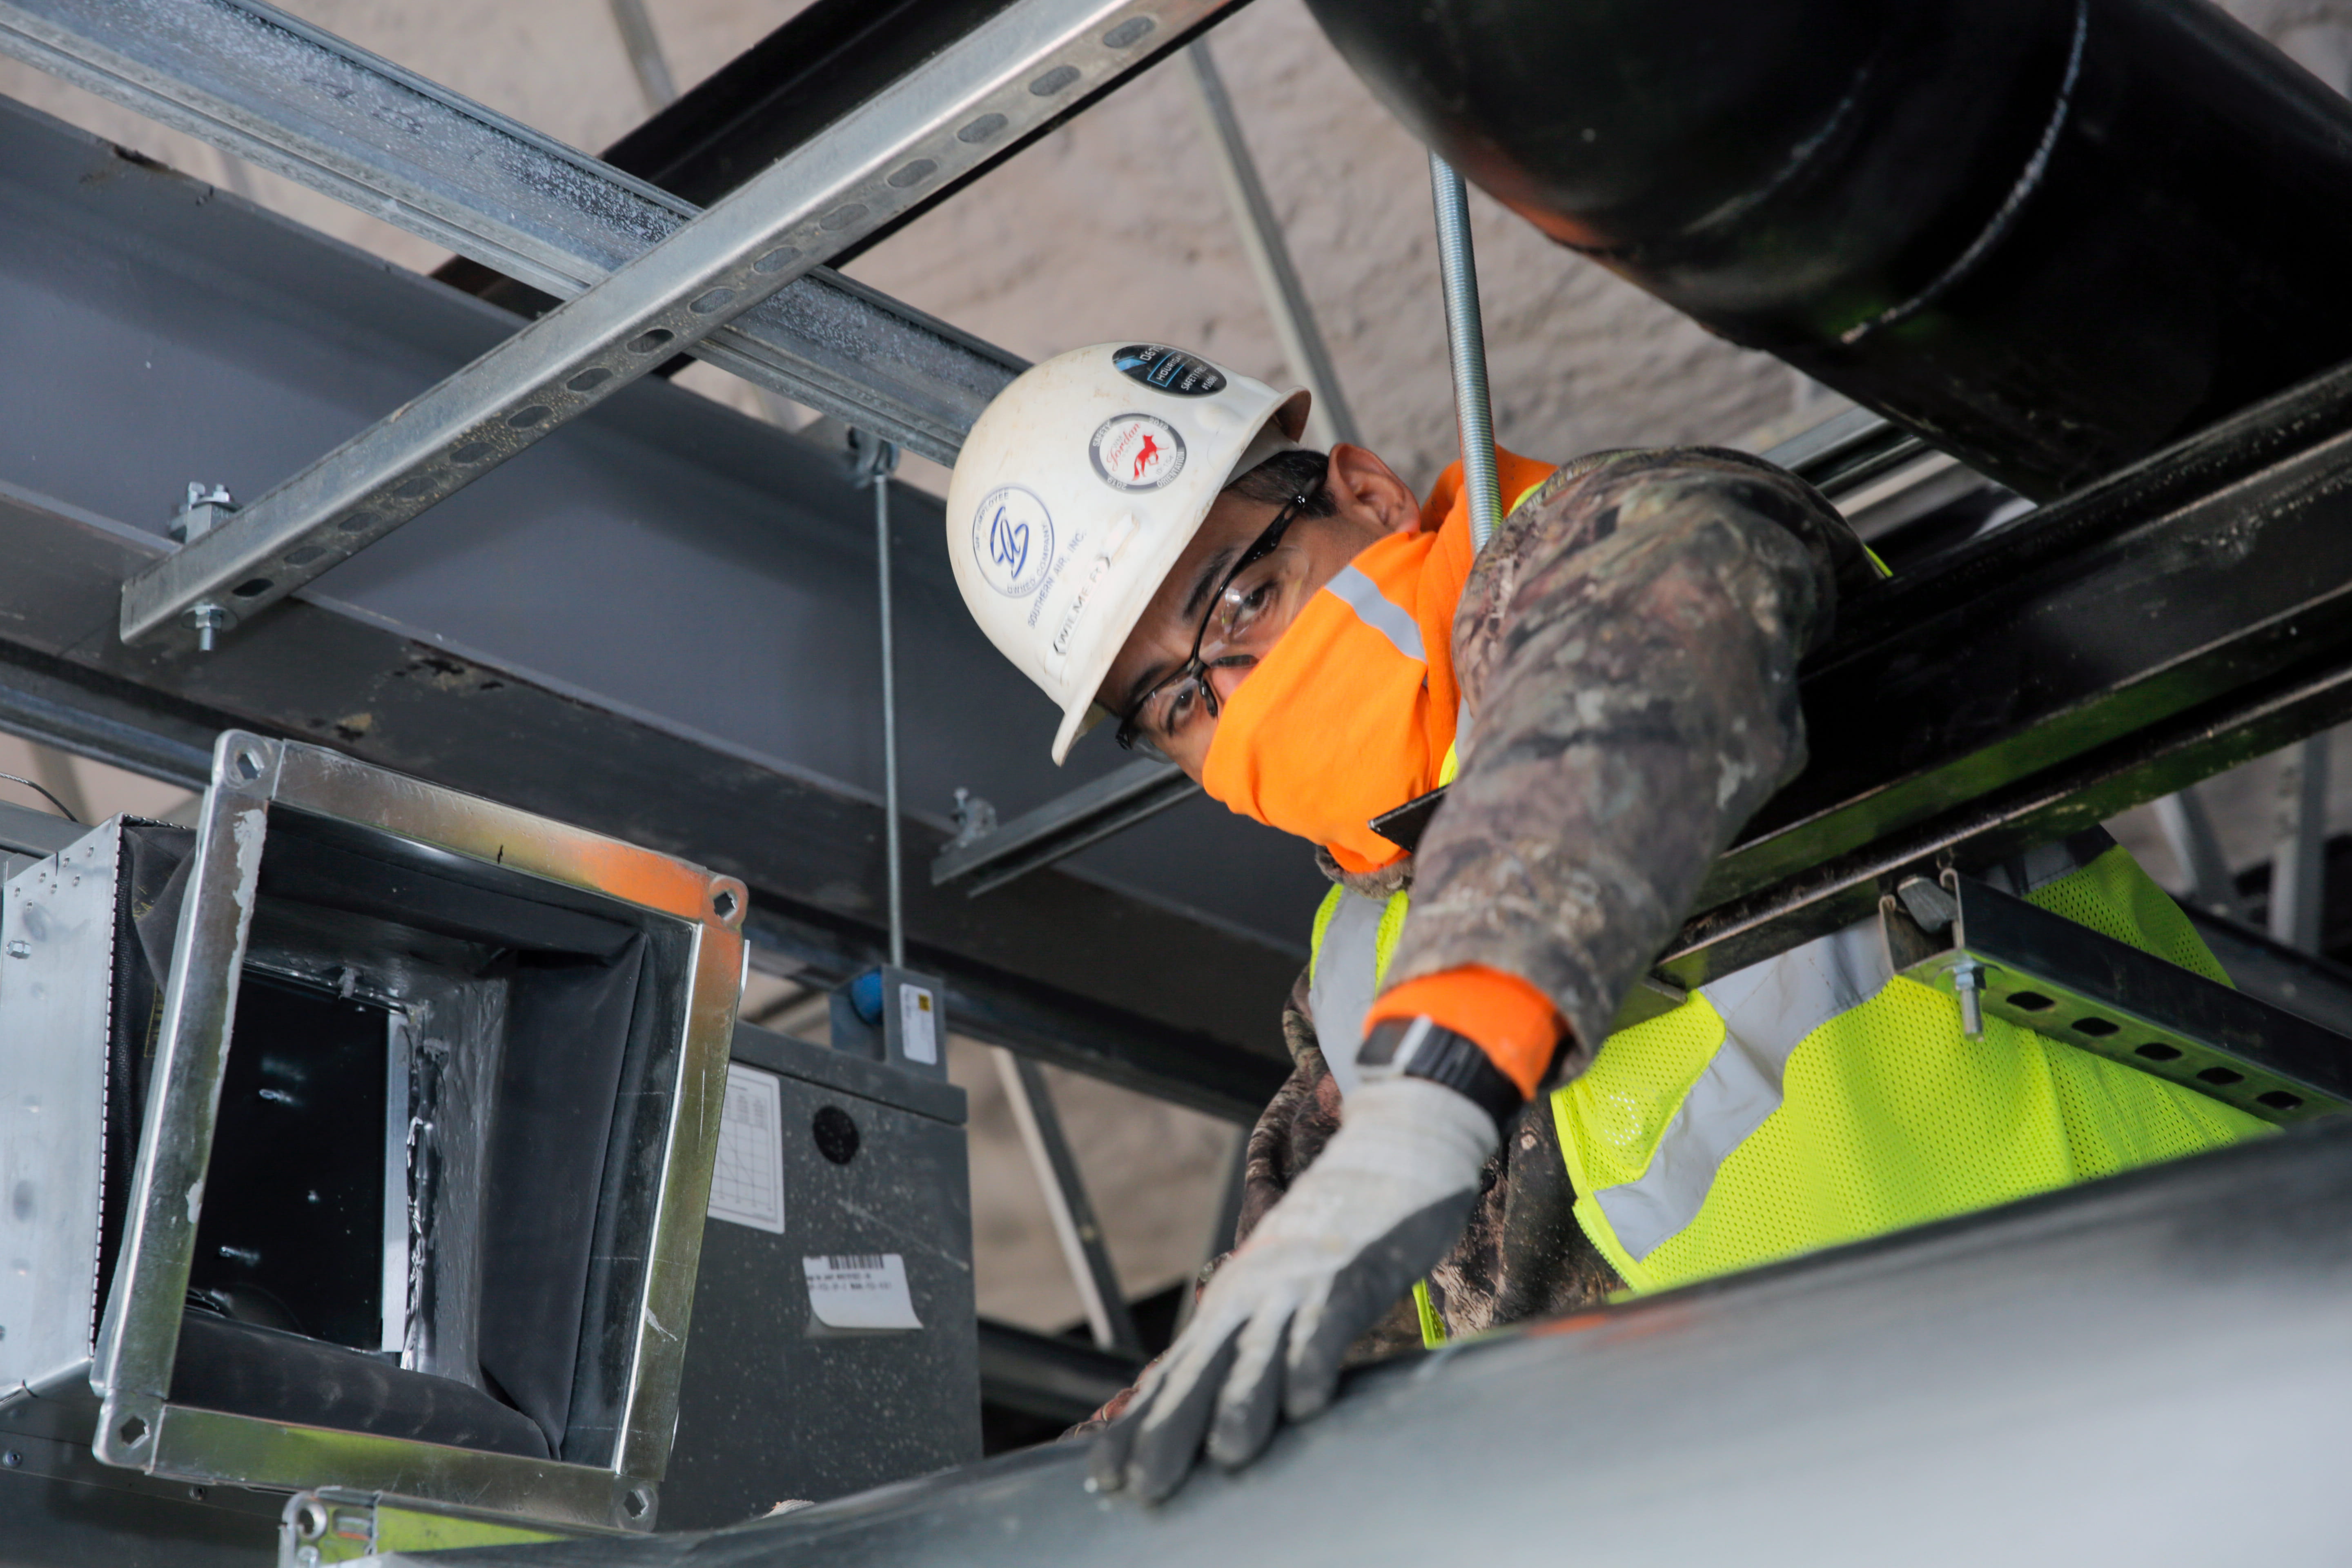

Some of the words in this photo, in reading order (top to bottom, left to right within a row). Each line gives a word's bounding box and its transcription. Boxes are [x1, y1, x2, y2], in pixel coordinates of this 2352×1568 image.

[1180, 370, 1199, 390] SAFETY
[1093, 421, 1111, 447] SAFETY
[1149, 417, 1169, 431] 2019
[1107, 423, 1141, 472] Jordan
[1107, 475, 1127, 490] 2019
[1157, 451, 1185, 488] ORIENTATION
[977, 488, 1009, 530] EMPLOYEE
[1007, 575, 1036, 594] OWNED
[1037, 523, 1050, 576] COMPANY
[1028, 577, 1055, 629] SOUTHERN
